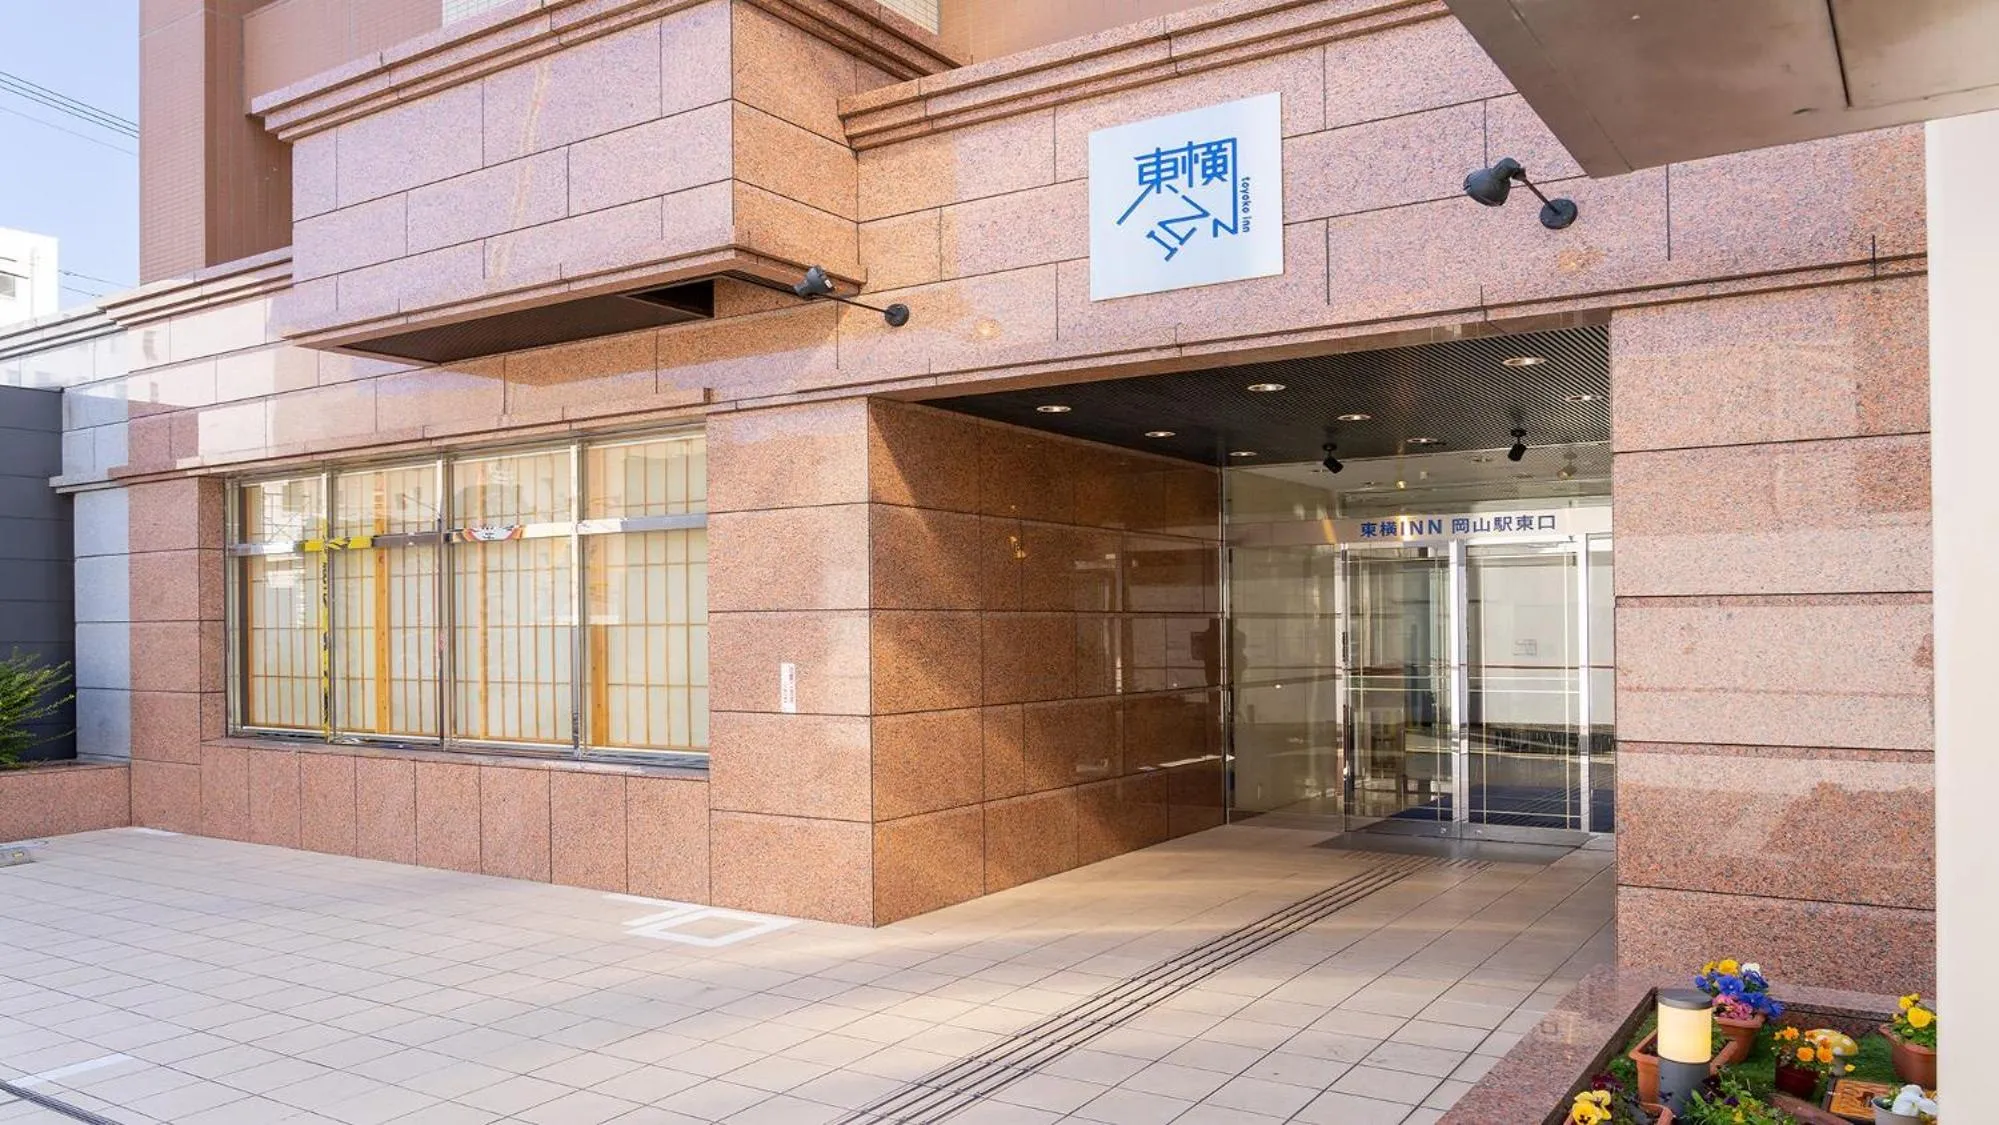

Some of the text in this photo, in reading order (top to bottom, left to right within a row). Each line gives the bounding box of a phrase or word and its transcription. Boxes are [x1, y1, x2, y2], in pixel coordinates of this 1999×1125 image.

[1240, 176, 1252, 233] toyoko inn
[1360, 515, 1556, 538] 東横INN 岡山駅東口
